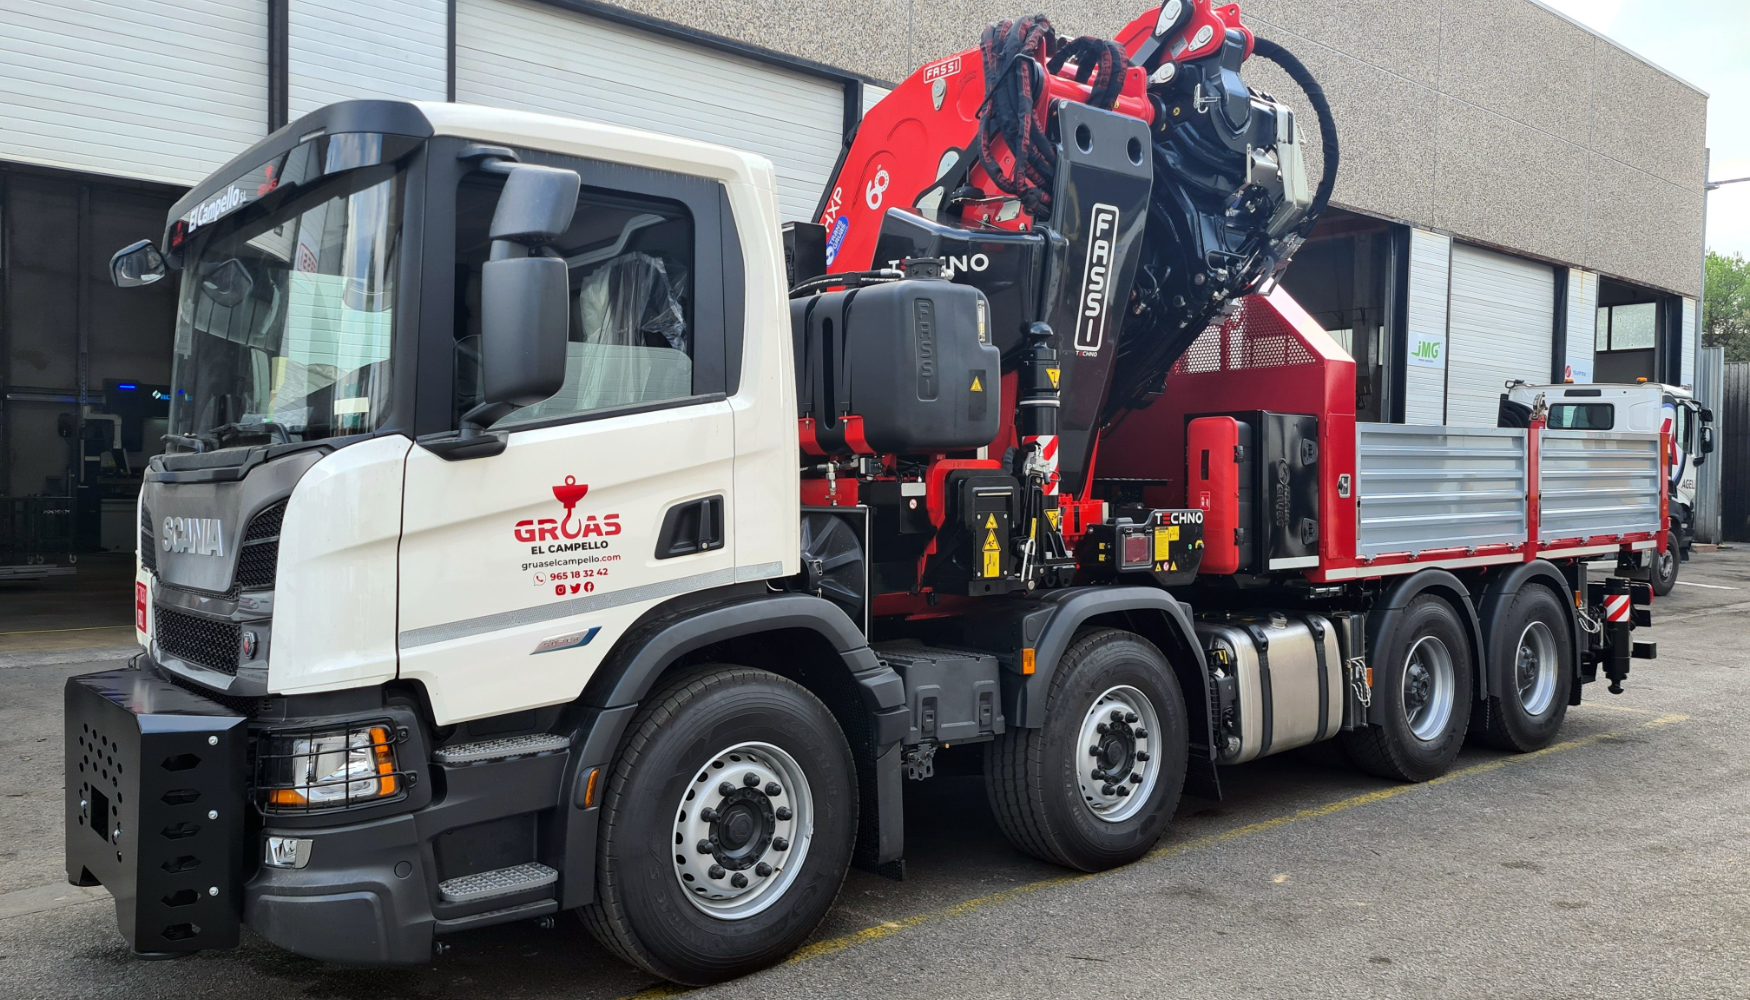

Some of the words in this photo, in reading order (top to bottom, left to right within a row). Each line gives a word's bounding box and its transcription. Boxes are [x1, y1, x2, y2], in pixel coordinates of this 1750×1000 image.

[926, 61, 958, 80] FASSI
[187, 206, 199, 233] El
[197, 185, 240, 226] Campello
[1084, 212, 1113, 343] FASSI
[917, 302, 932, 397] FASSI
[1075, 350, 1098, 358] TECHNO
[514, 513, 622, 543] GRUAS
[1154, 512, 1204, 525] TECHNO
[161, 516, 224, 557] SCANIA
[531, 546, 545, 555] EL
[548, 540, 609, 554] CAMPELLO
[521, 554, 621, 571] gruaselcampello.com
[550, 572, 568, 581] 965
[570, 571, 581, 579] 18
[583, 569, 594, 578] 32
[597, 568, 609, 576] 42
